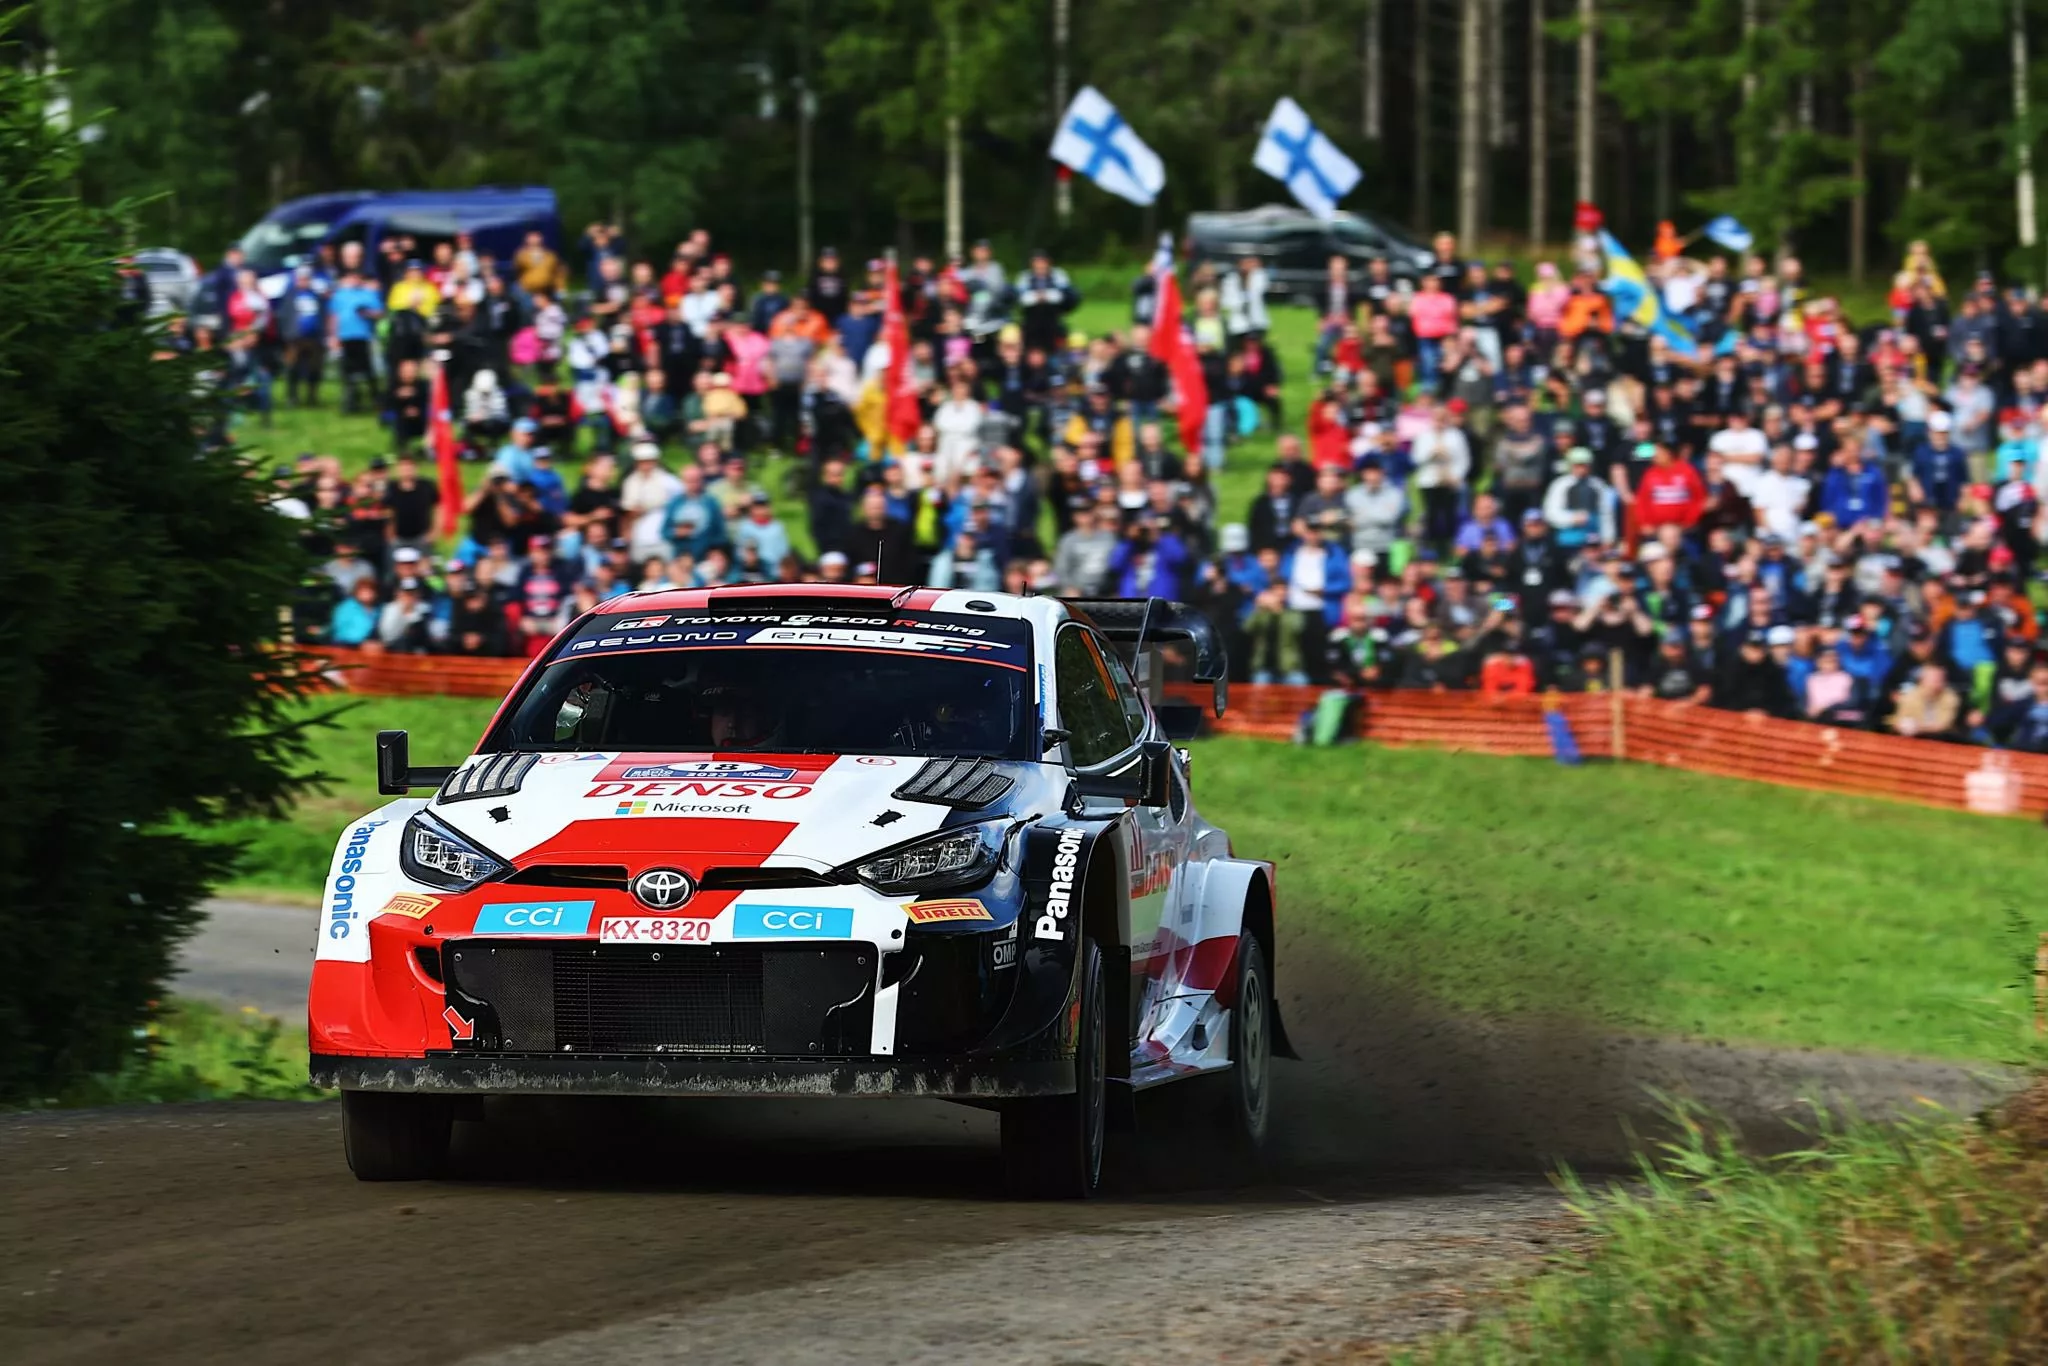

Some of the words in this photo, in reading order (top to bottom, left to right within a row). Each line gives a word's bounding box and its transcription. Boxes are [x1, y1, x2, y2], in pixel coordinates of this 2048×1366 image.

[674, 615, 780, 625] TOYOTA
[892, 618, 986, 634] Racing
[572, 631, 738, 651] BEYOND
[771, 632, 905, 644] RALLY
[695, 762, 740, 771] 18
[583, 782, 812, 799] DENSO
[652, 802, 752, 814] Microsoft
[330, 820, 390, 940] Panasonic
[1035, 827, 1087, 942] Panasonic
[383, 895, 434, 915] PIRELLI
[908, 902, 986, 920] PIRELLI
[603, 919, 711, 941] KX-8320
[993, 942, 1017, 965] OMP
